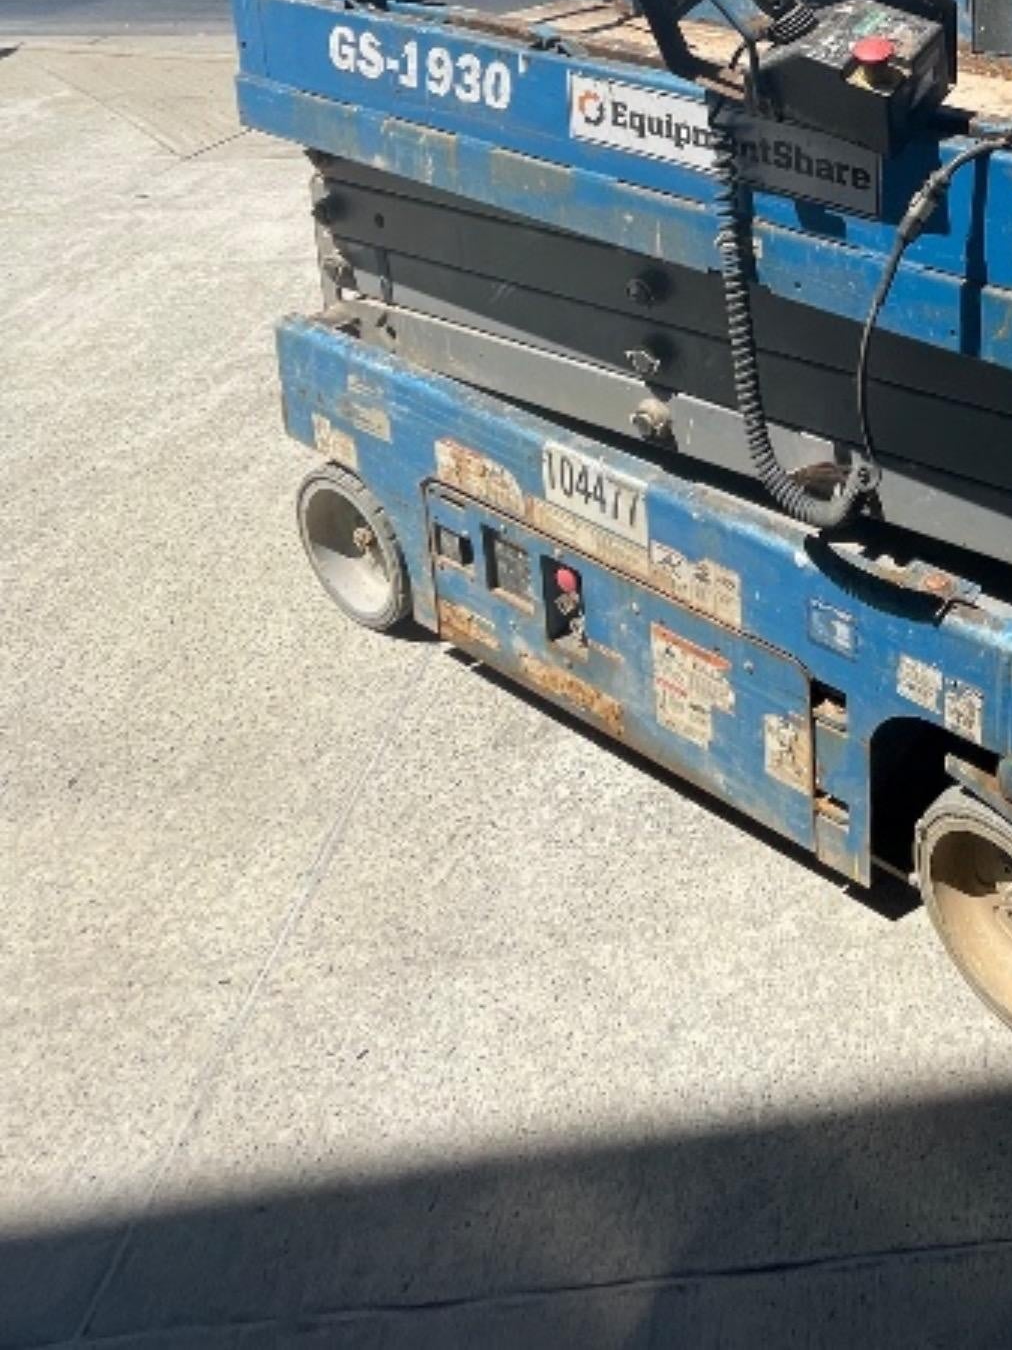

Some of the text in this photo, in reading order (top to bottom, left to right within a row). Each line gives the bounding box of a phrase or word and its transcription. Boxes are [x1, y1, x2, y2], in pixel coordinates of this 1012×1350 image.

[329, 25, 511, 110] GS-1930
[610, 101, 872, 191] EquipmntShare
[545, 449, 642, 527] 104477
